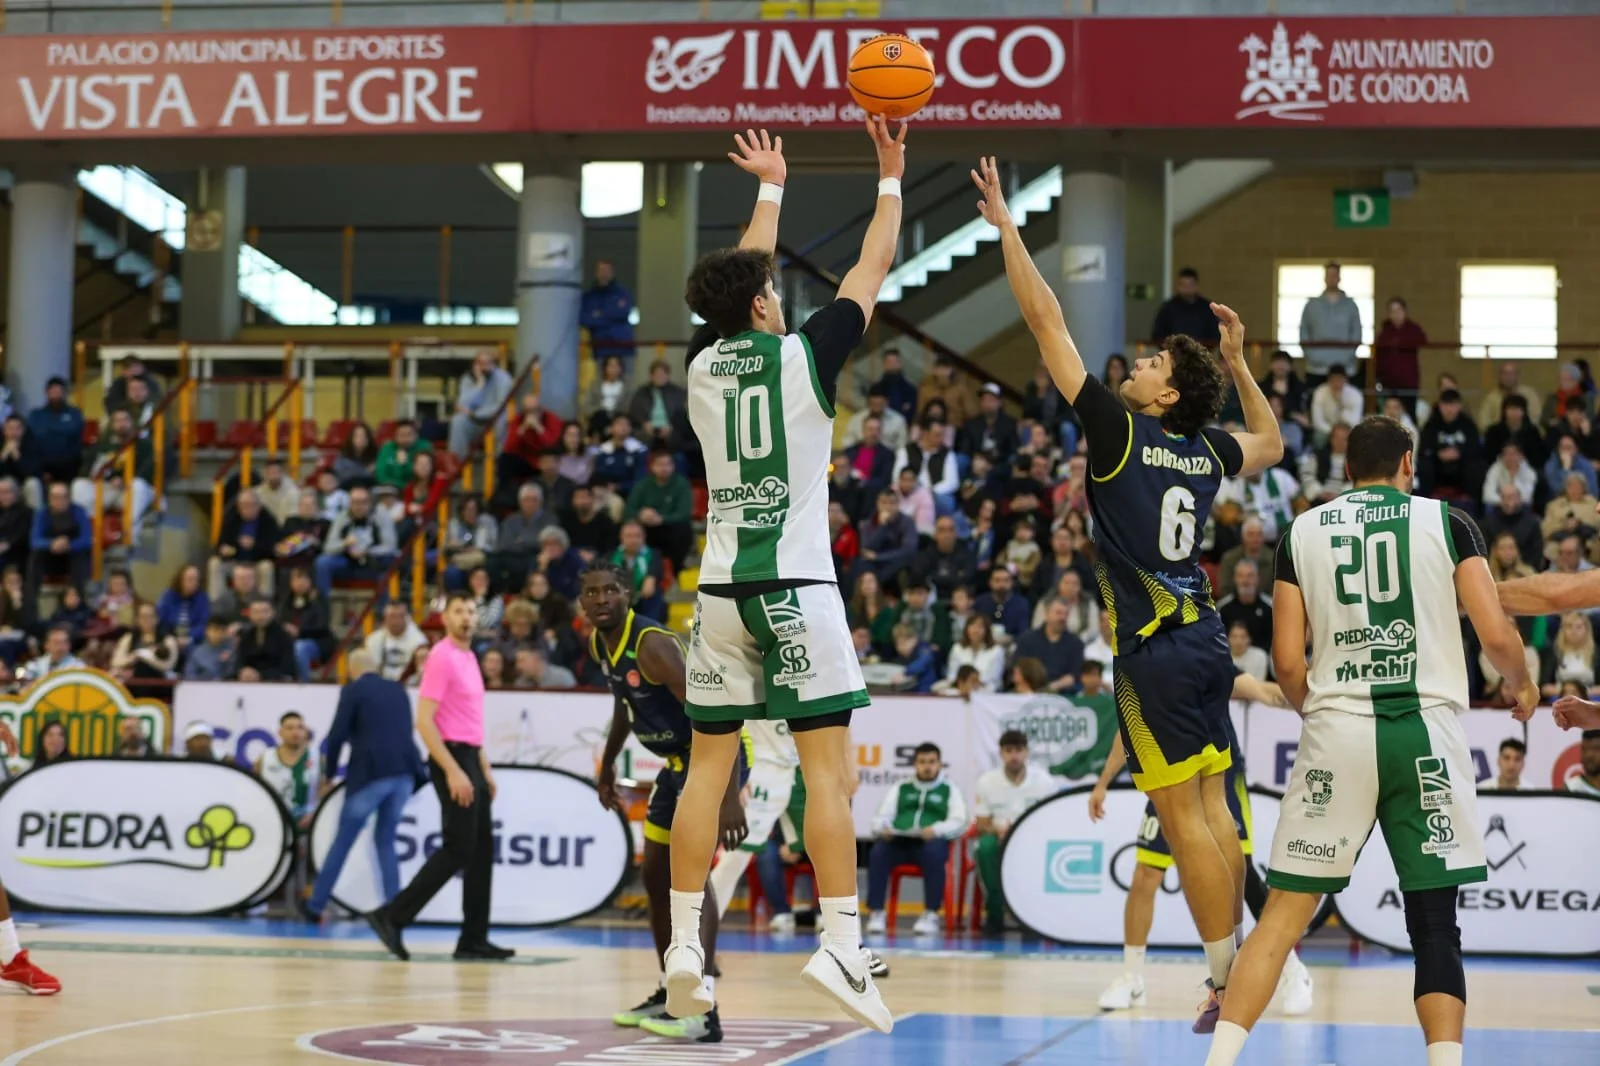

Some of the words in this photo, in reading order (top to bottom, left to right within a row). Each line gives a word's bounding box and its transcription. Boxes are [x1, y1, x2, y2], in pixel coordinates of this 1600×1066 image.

[47, 41, 158, 66] PALACIO
[164, 37, 306, 64] MUNICIPAL
[313, 34, 445, 61] DEPORTES
[1328, 38, 1494, 69] AYUNTAMIENTO
[17, 73, 197, 130] VISTA
[219, 66, 482, 127] ALEGRE
[1328, 74, 1357, 103] DE
[1361, 70, 1470, 103] CÓRDOBA
[646, 102, 730, 123] Instituto
[734, 101, 835, 125] Municipal
[971, 99, 1062, 120] Córdoba
[1349, 194, 1374, 222] D
[711, 355, 763, 376] OROZCO
[723, 384, 772, 462] 10
[1159, 485, 1197, 561] 6
[1319, 509, 1346, 526] DEL
[1355, 503, 1409, 524] ÁGUILA
[1331, 531, 1400, 605] 20
[1287, 839, 1336, 858] efficold
